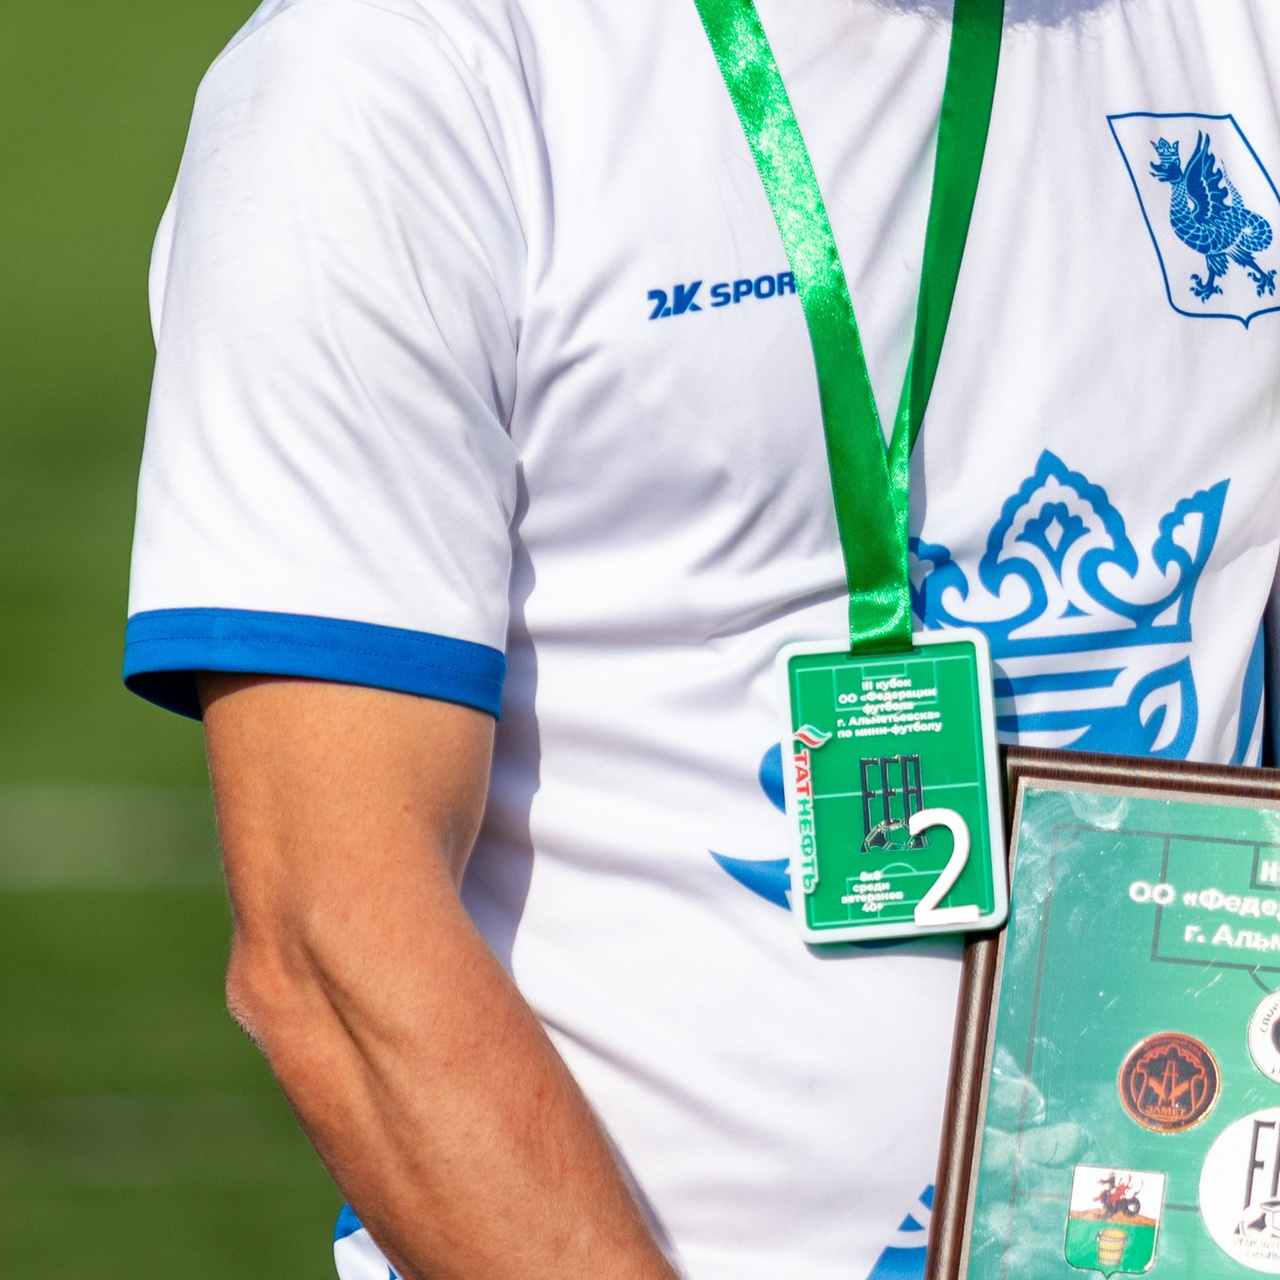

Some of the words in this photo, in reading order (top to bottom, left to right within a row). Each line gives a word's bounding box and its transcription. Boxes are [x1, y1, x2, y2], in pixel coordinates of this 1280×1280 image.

[710, 271, 798, 307] SPOR
[875, 677, 912, 691] кубок
[860, 688, 937, 702] «Федерации
[862, 701, 914, 715] футбола
[837, 719, 846, 727] г.
[848, 711, 941, 726] Альметьевска»
[837, 730, 853, 738] по
[855, 722, 943, 737] мини-футболу
[794, 749, 818, 893] ТАТНЕФТЬ
[909, 807, 980, 926] 2
[852, 882, 891, 894] среди
[1129, 881, 1176, 905] ОО
[841, 891, 904, 904] ветеранов
[1184, 924, 1206, 943] г.
